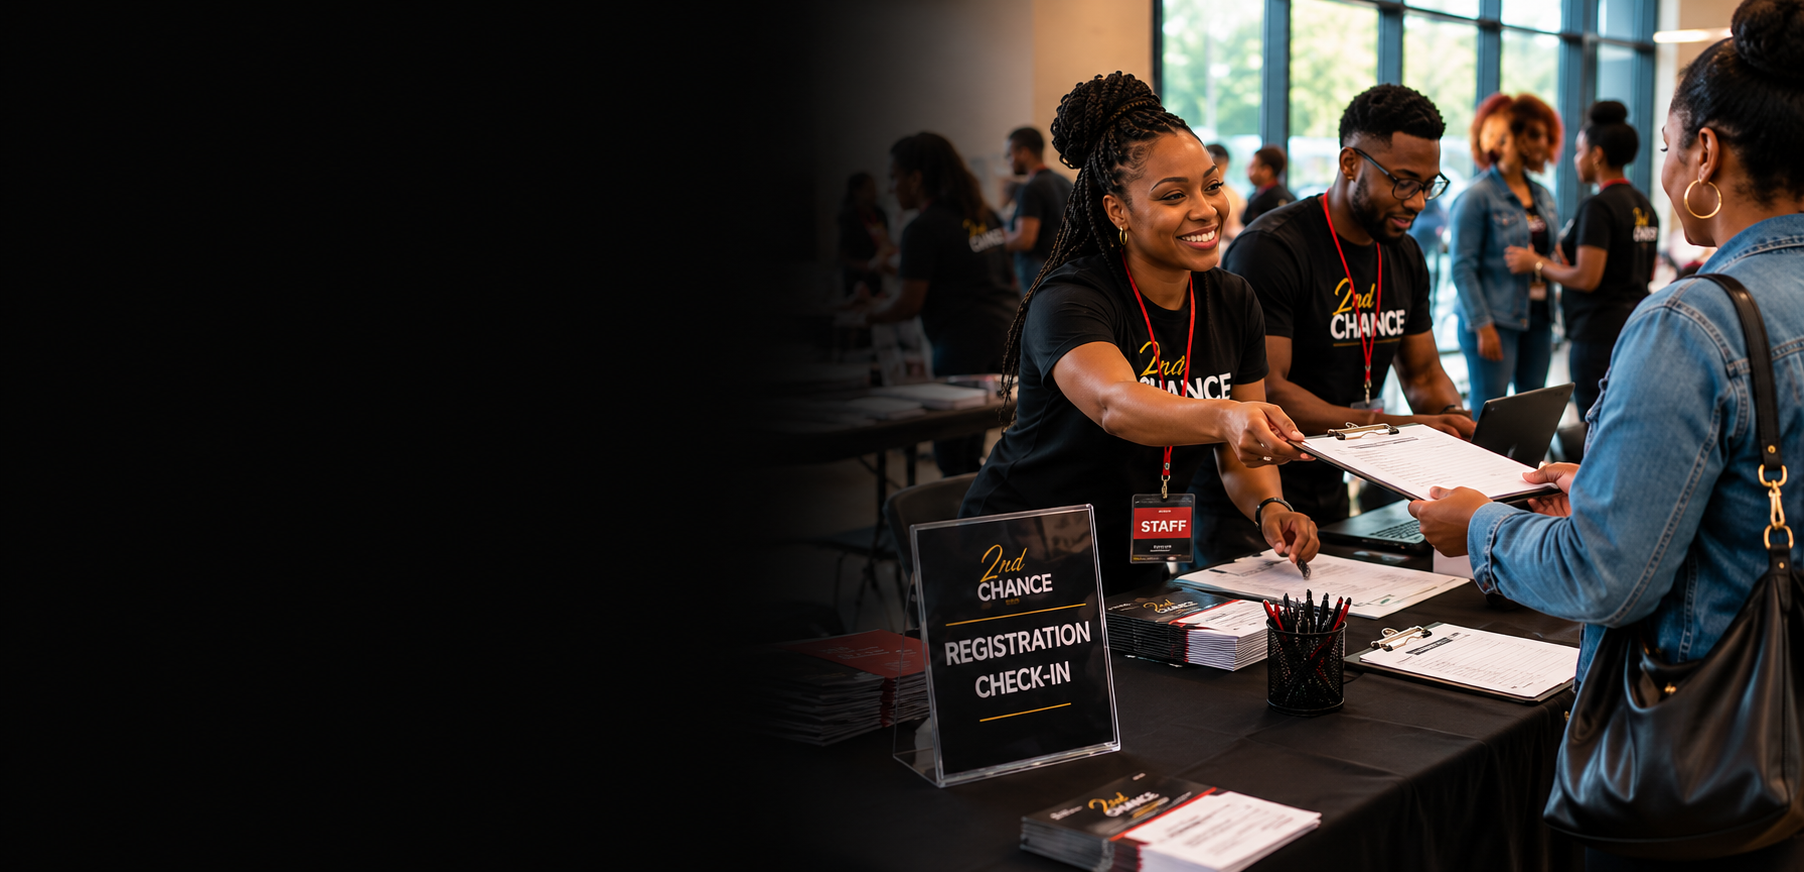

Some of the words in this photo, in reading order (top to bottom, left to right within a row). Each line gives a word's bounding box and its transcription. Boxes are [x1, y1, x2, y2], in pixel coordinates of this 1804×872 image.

[1332, 277, 1376, 316] 2nd
[1330, 309, 1406, 340] CHANCE
[1141, 520, 1187, 533] STAFF
[980, 544, 1027, 583] 2nd
[977, 573, 1053, 602] CHANCE
[944, 620, 1091, 666] REGISTRATION
[974, 660, 1071, 699] CHECK-IN
